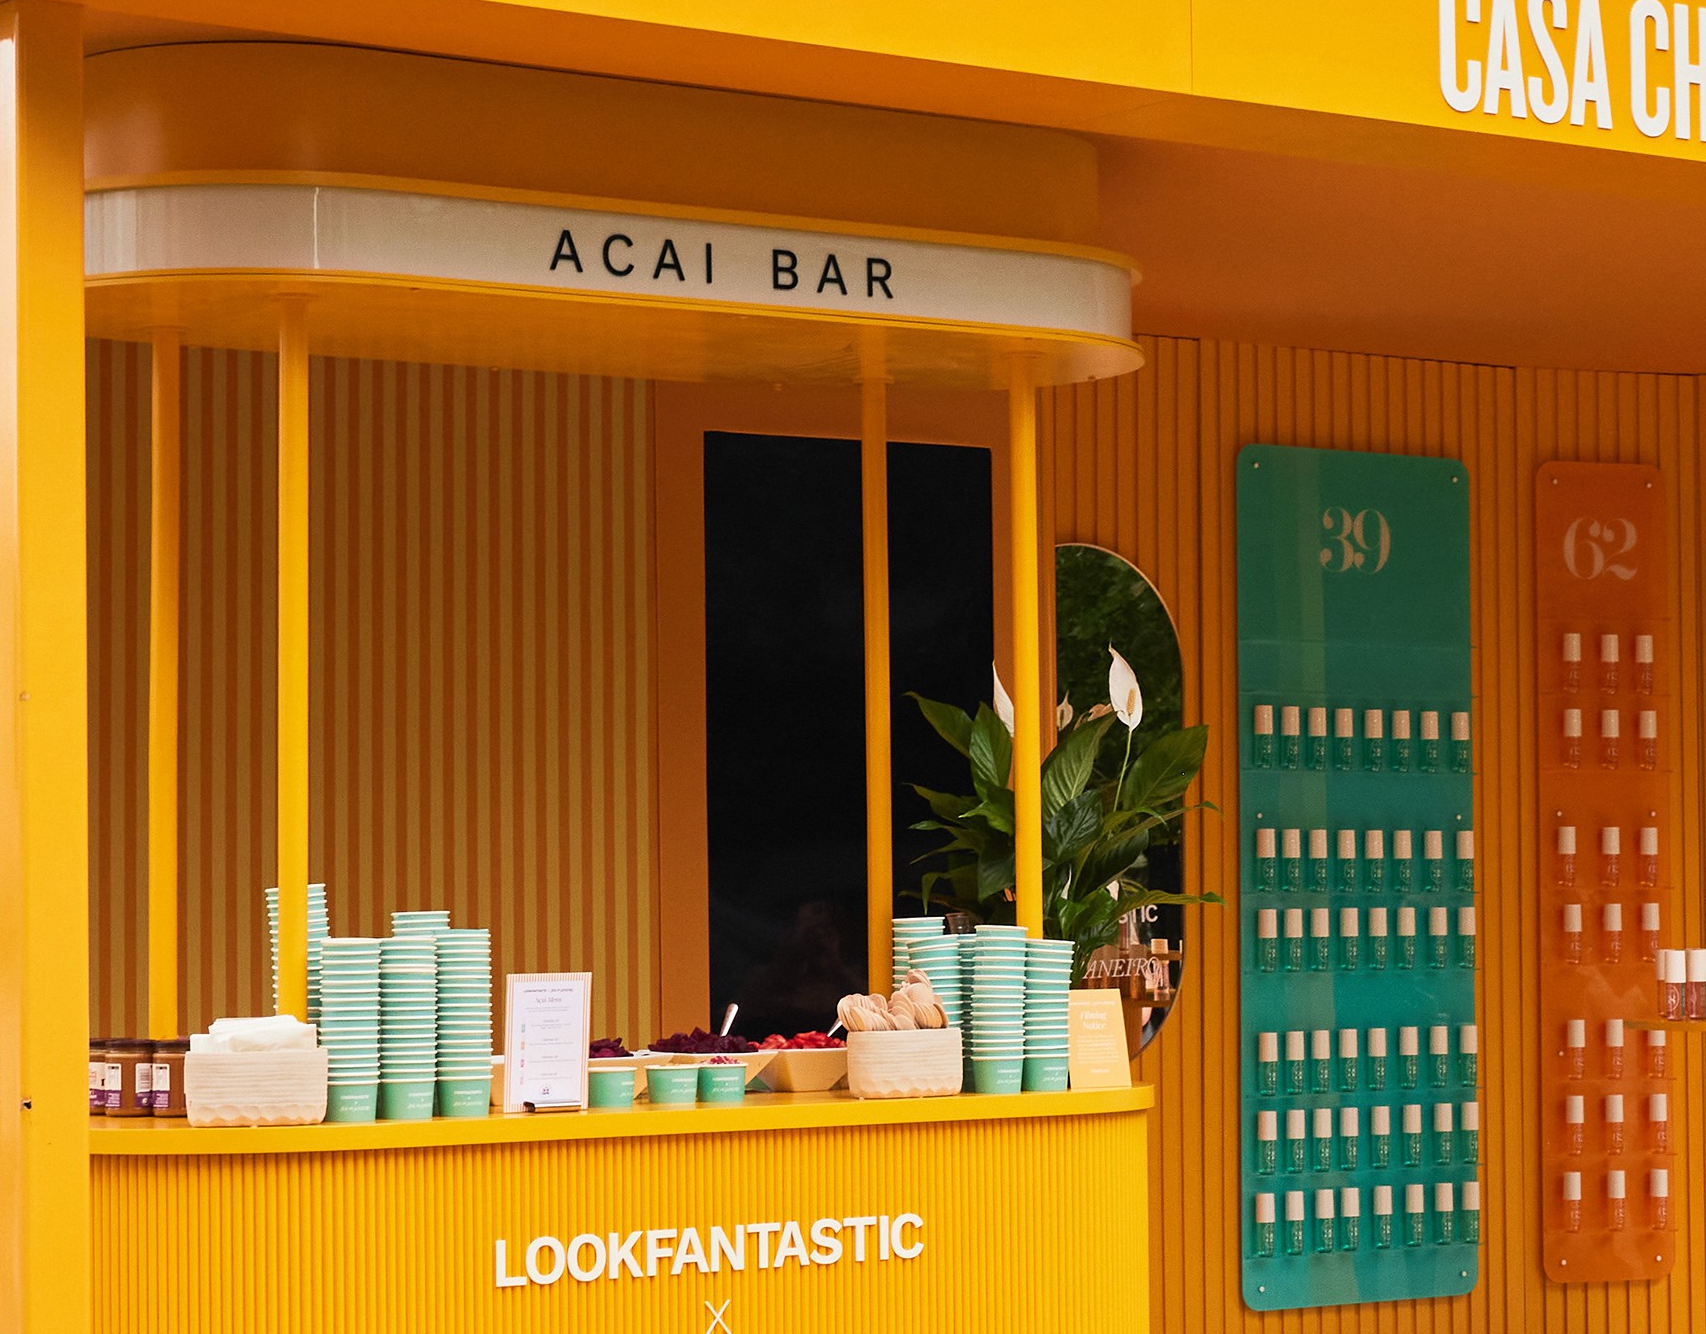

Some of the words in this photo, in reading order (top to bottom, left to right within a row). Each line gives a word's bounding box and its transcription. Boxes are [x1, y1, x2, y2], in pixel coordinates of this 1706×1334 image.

[548, 229, 714, 285] ACAI
[772, 249, 896, 299] BAR
[1319, 505, 1392, 575] 39
[1562, 516, 1639, 582] 62
[1083, 956, 1163, 988] ANEIRO
[495, 1212, 925, 1289] LOOKFANTASTIC
